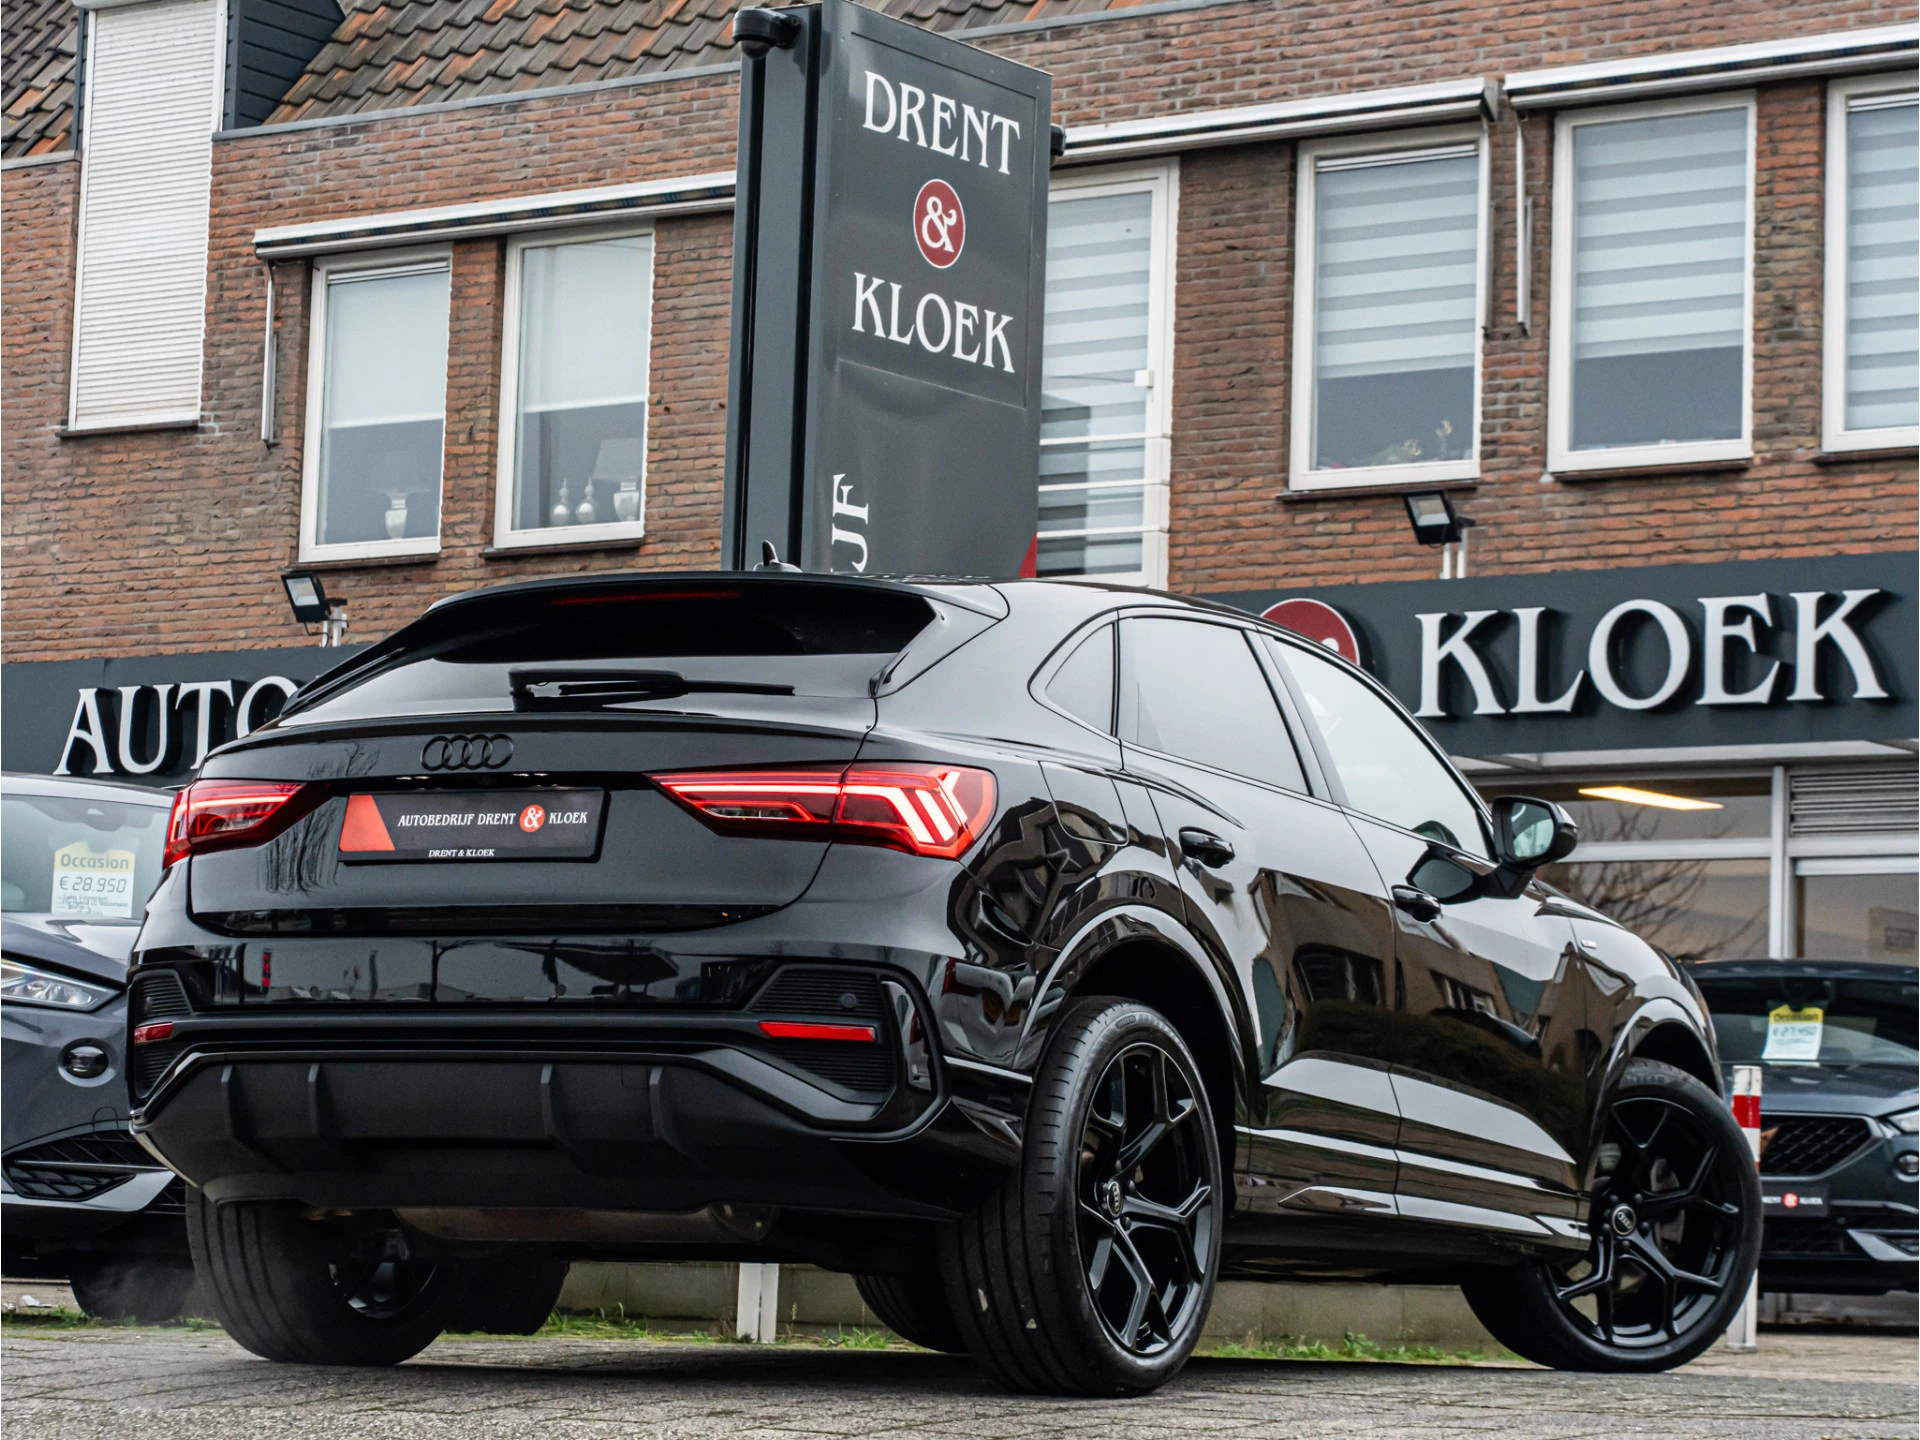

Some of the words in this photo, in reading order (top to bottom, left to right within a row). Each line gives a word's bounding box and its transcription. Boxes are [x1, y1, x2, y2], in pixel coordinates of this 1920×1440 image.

[862, 69, 1021, 175] DRENT
[921, 195, 958, 254] &
[851, 272, 1016, 375] KLOEK
[831, 473, 869, 573] JF
[1414, 588, 1892, 718] KLOEK
[398, 813, 475, 827] AUTOBEDRIJF
[477, 812, 517, 825] DRENT
[523, 807, 543, 829] &
[548, 811, 588, 825] KLOEK
[60, 853, 129, 870] Occasion
[428, 849, 457, 858] DRENT
[457, 849, 465, 857] &
[465, 848, 496, 857] KLOEK
[59, 875, 69, 891] €
[72, 876, 127, 894] 28.950
